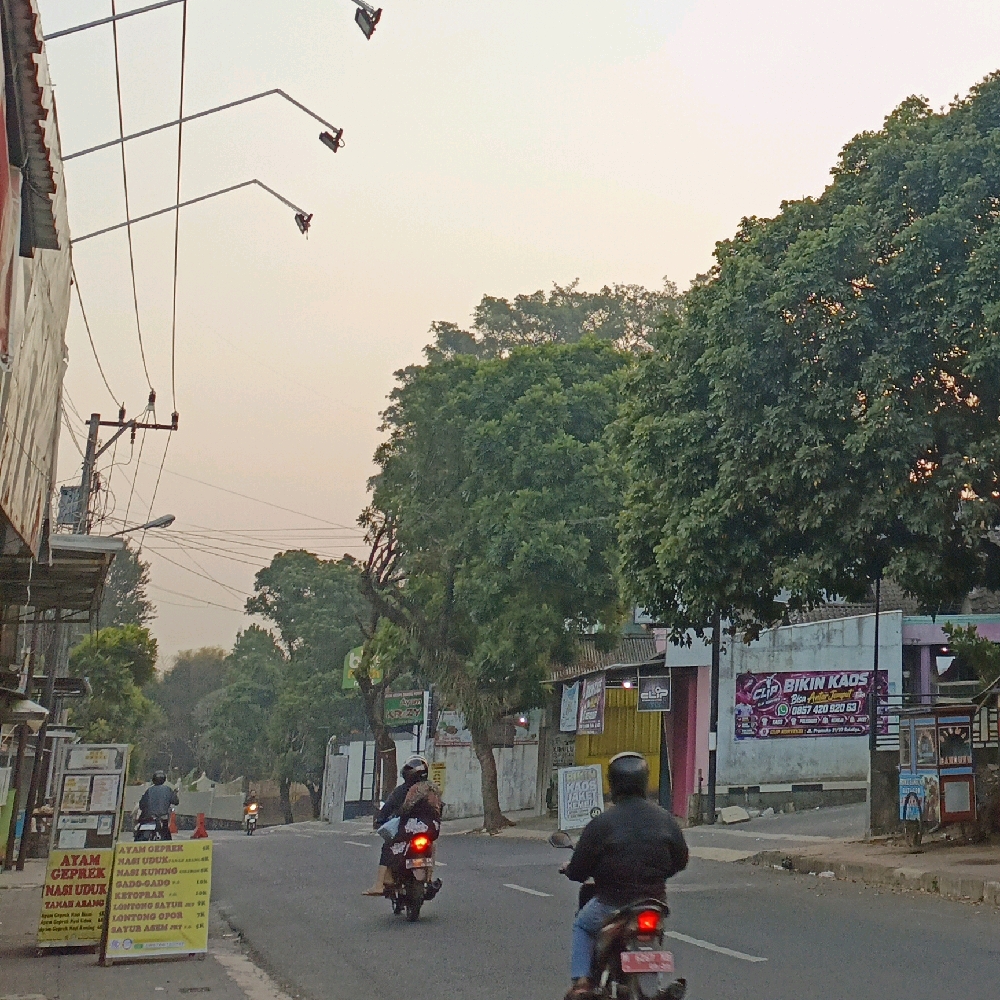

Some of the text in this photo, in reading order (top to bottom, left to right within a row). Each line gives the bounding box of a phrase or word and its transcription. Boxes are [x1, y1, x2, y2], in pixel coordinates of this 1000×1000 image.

[783, 672, 869, 693] BIKIN KAOS
[566, 781, 597, 793] KAOS
[118, 846, 146, 854] AYAM
[148, 844, 184, 853] GEPREK
[60, 854, 101, 867] AYAM
[117, 857, 140, 865] NASI
[142, 856, 169, 864] UDUK
[50, 867, 106, 880] GEPREK
[116, 869, 140, 877] NASI
[141, 867, 178, 876] KUNING
[115, 879, 171, 888] GADO-GADO
[45, 883, 107, 897] NASI UDUK
[114, 891, 165, 900] KETOPRAK
[75, 899, 105, 908] ABANG
[113, 902, 154, 911] LONTONG
[154, 901, 183, 909] SAYUR
[112, 913, 157, 922] LONTONG
[158, 912, 183, 920] OPOR
[111, 925, 142, 934] SAYUR
[144, 923, 168, 932] ASEM
